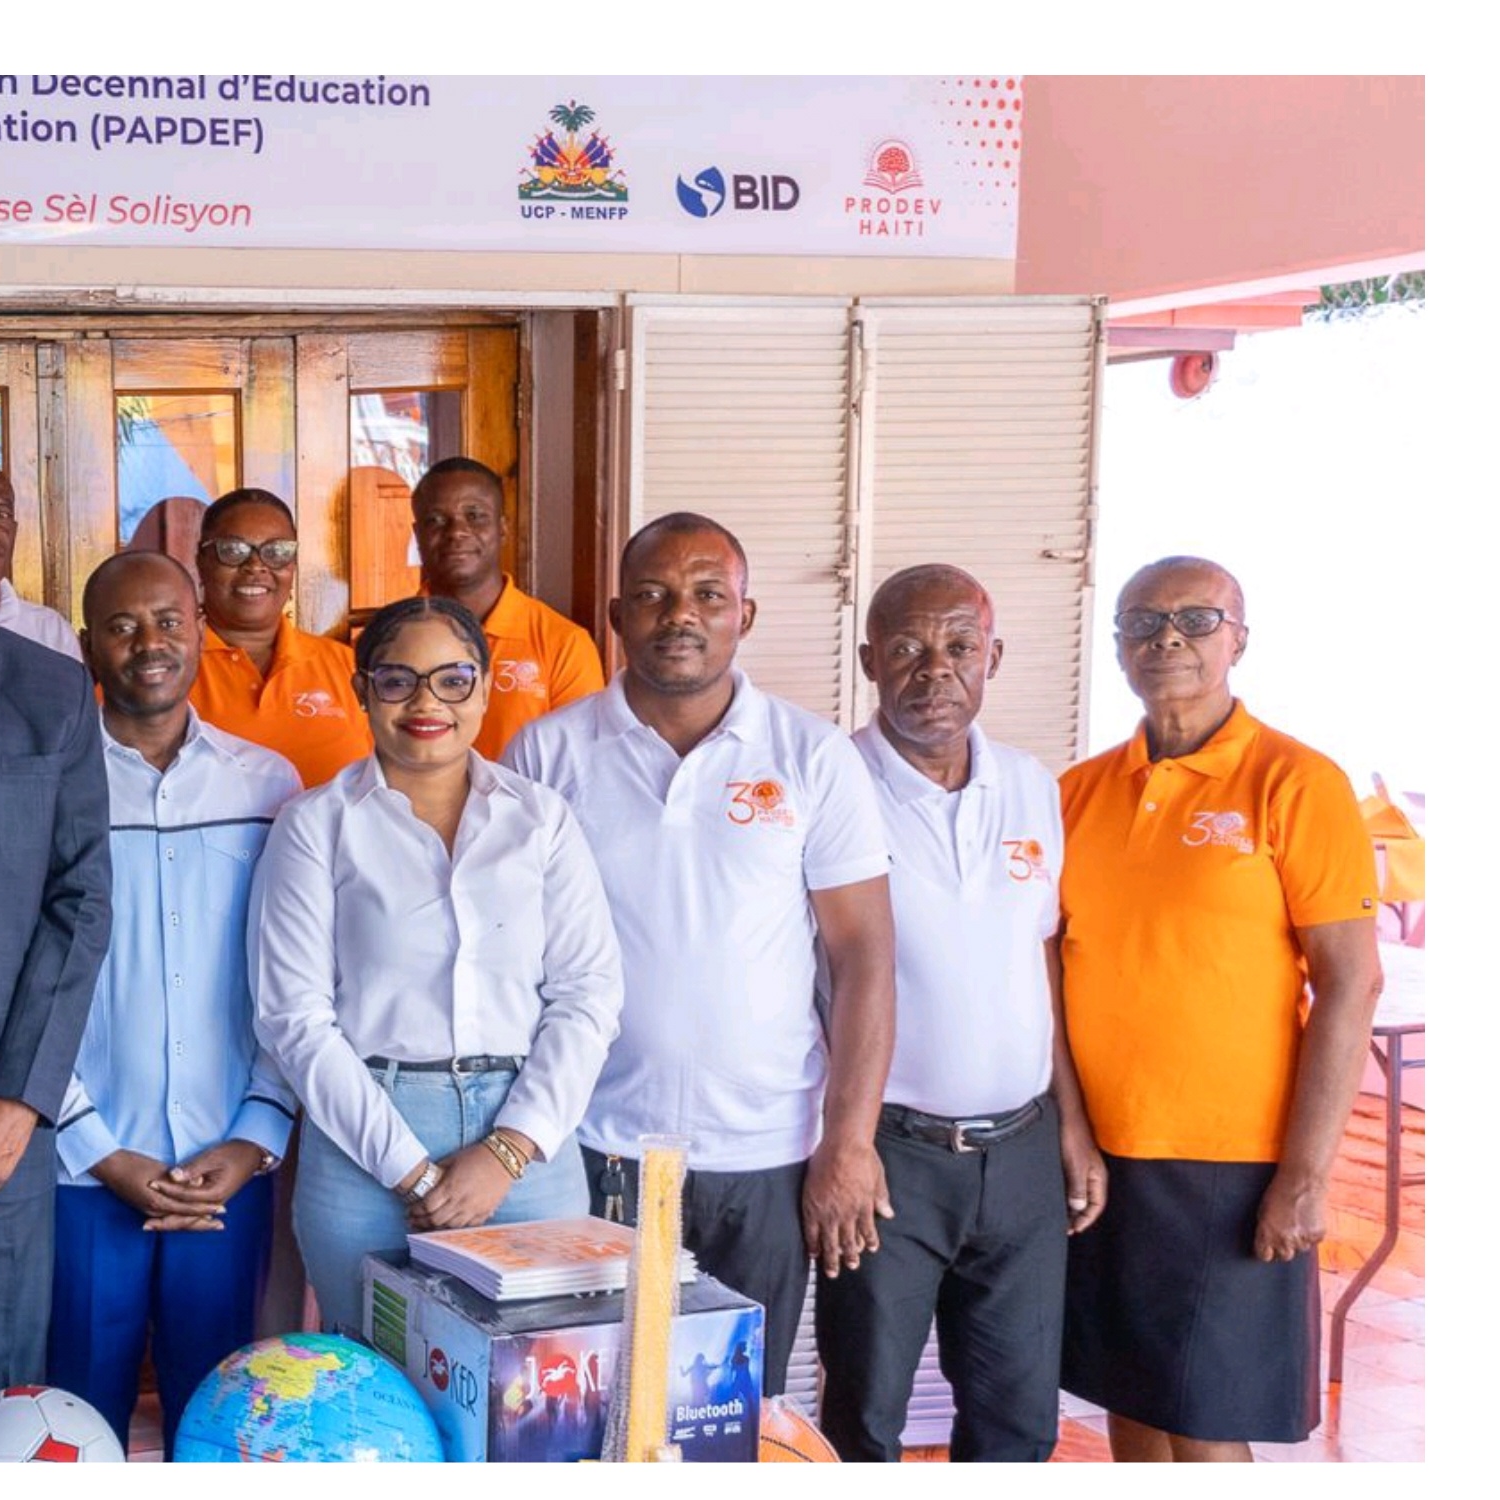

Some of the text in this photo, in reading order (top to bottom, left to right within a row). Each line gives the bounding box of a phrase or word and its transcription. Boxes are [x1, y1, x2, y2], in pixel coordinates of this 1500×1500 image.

[91, 113, 265, 154] (PAPDEF)
[731, 174, 800, 211] BID
[43, 194, 97, 224] Sèl
[107, 195, 252, 233] Solisyon
[520, 205, 556, 220] UCP
[571, 206, 629, 221] MENFP
[845, 197, 942, 216] PRODEV
[858, 219, 925, 237] HAITI
[676, 1399, 744, 1422] Bluetooth
